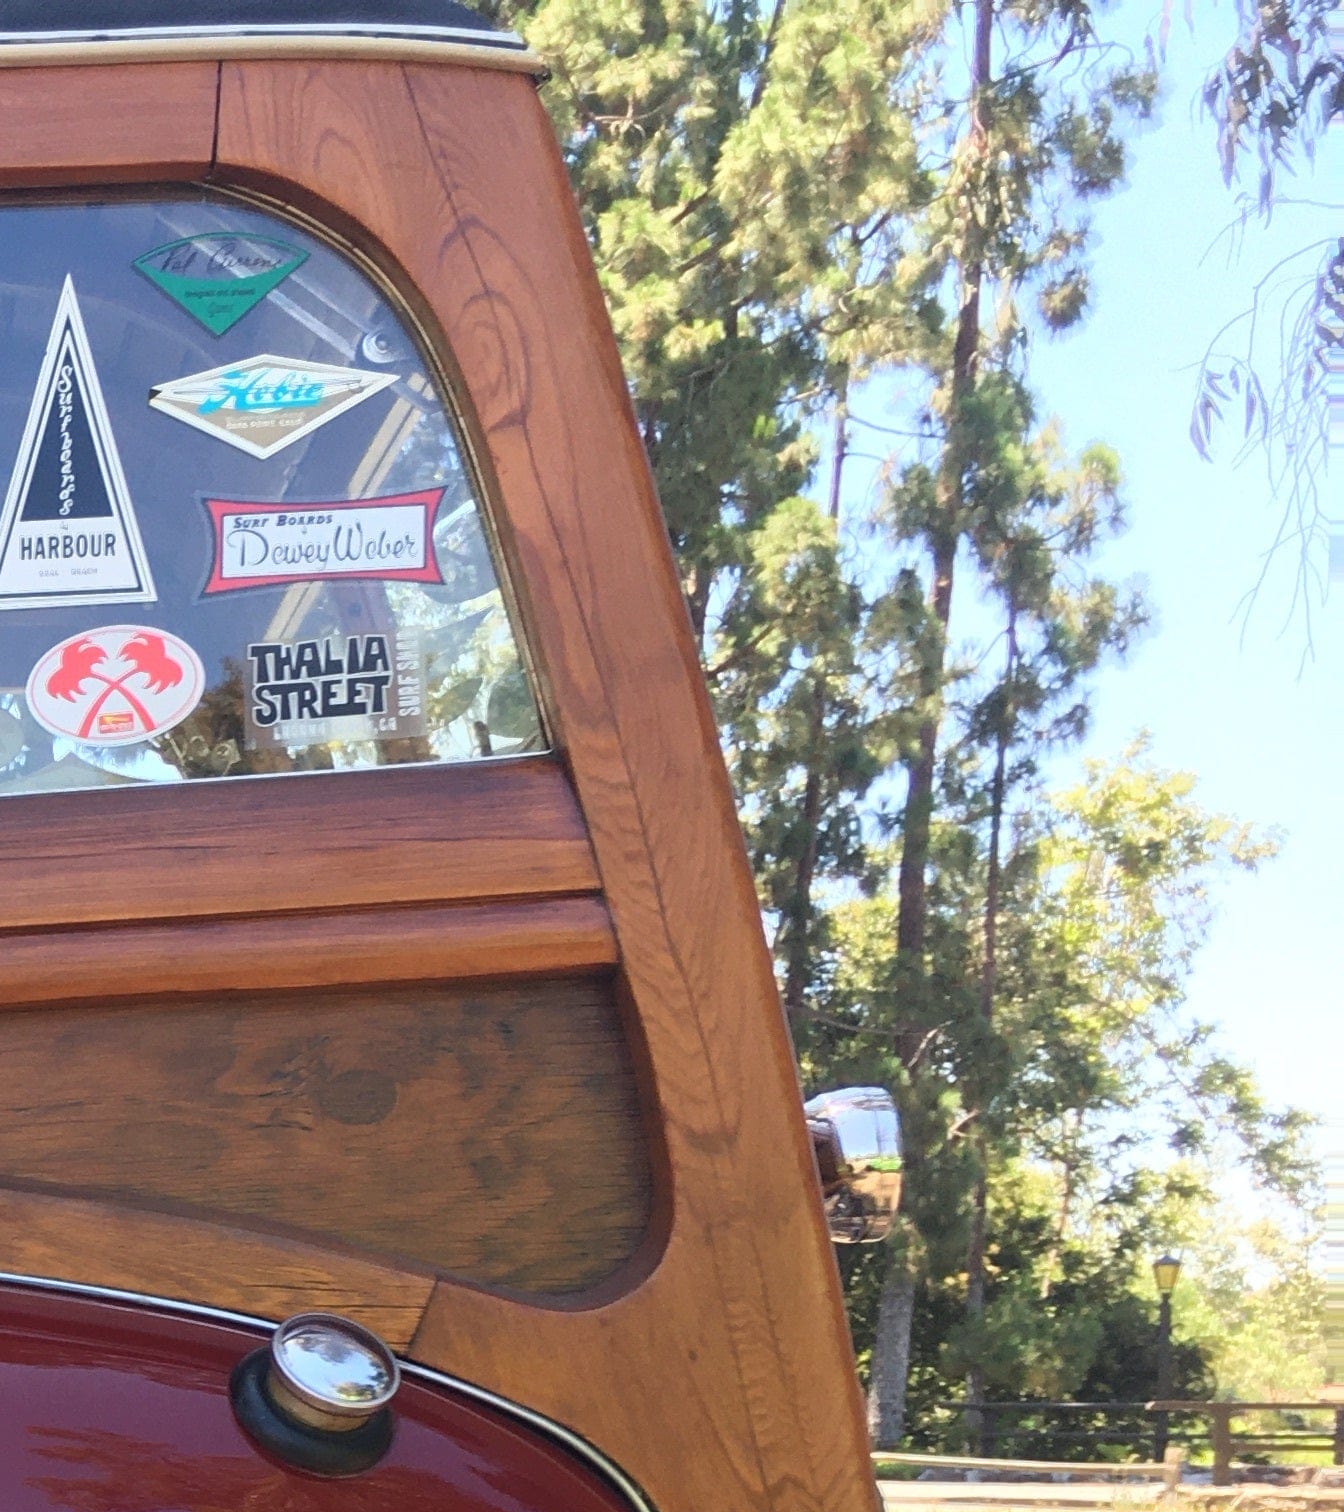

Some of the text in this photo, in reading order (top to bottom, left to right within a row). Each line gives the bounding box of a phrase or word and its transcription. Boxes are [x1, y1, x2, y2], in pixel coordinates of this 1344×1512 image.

[197, 368, 324, 415] Hobie
[56, 364, 76, 516] Surfboards
[18, 533, 117, 561] HARBOUR
[226, 521, 418, 571] Dewey Weber
[247, 634, 393, 684] THALIA
[252, 675, 393, 727] STREET
[397, 674, 421, 717] SURF
